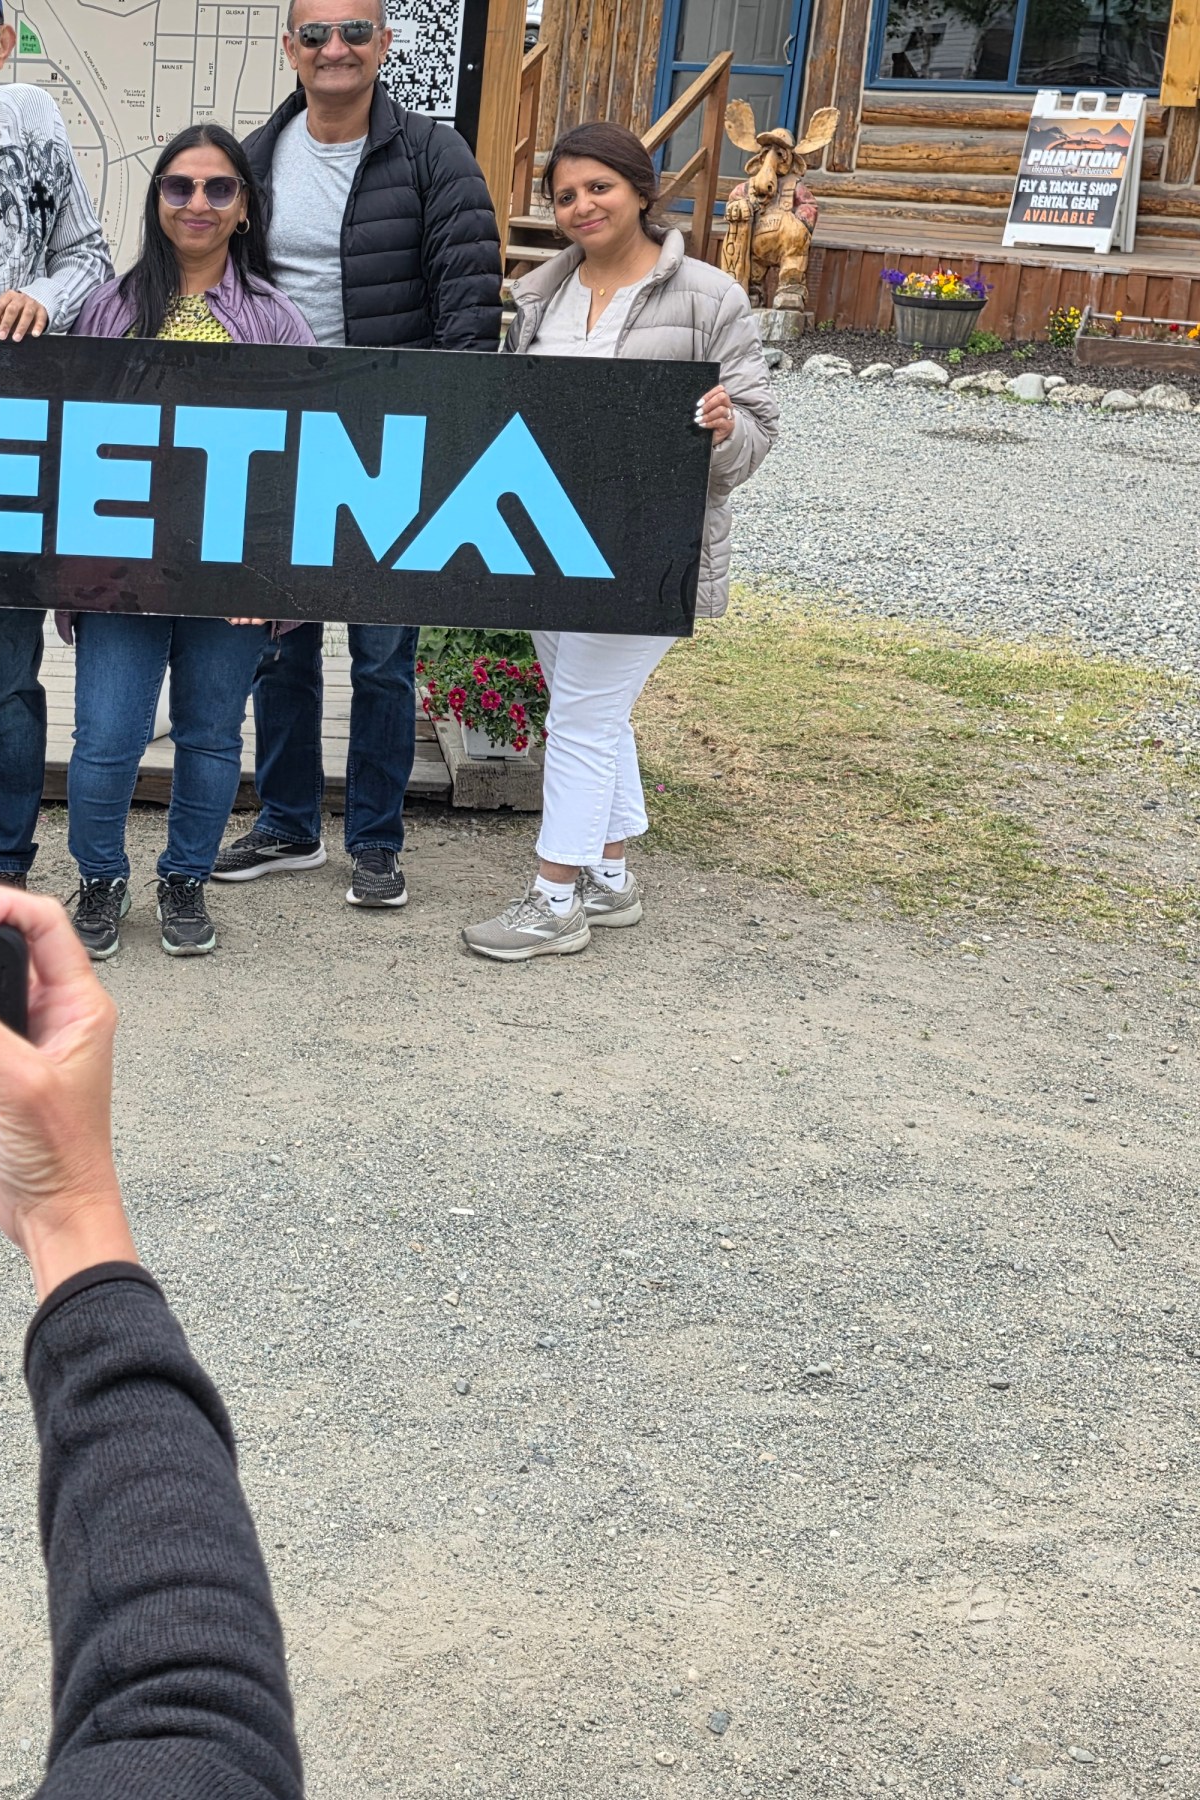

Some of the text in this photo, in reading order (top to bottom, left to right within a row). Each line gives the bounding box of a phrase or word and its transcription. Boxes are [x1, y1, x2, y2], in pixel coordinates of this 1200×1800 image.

[84, 50, 95, 68] ALASKA
[1027, 149, 1123, 169] PHANTOM
[1018, 179, 1118, 197] FLY & TACKLE SHOP
[1030, 195, 1100, 211] RENTAL GEAR
[1023, 209, 1096, 225] AVAILABLE
